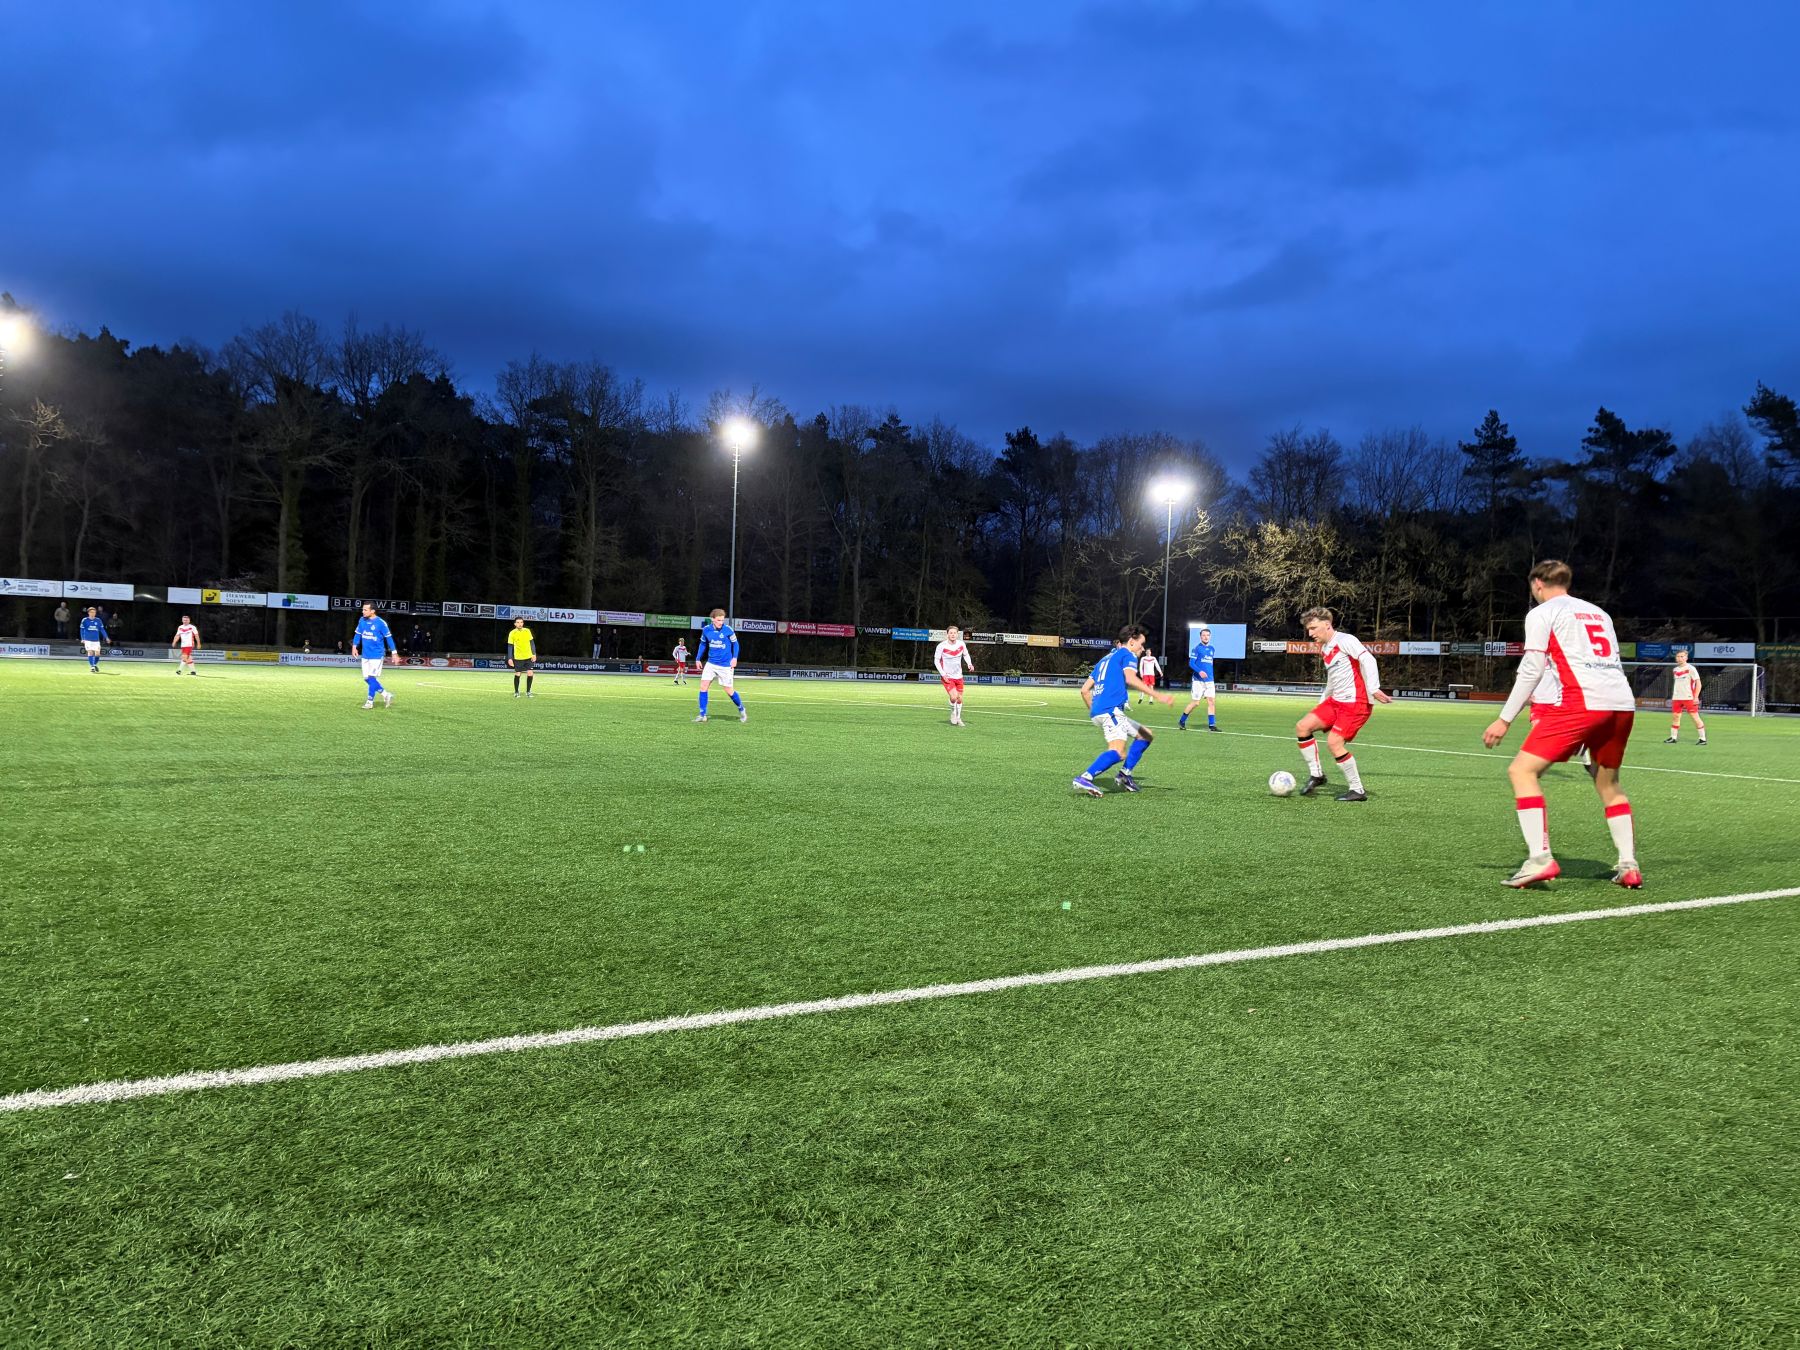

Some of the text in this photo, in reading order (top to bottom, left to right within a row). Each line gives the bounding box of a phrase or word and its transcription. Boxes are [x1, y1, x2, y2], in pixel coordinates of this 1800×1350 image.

[334, 599, 408, 610] BROWER
[743, 622, 775, 632] Rabobank
[1584, 624, 1611, 657] 5
[1288, 643, 1307, 652] ING
[1366, 643, 1382, 652] NG
[577, 664, 606, 672] together
[858, 673, 907, 681] stalenhoef
